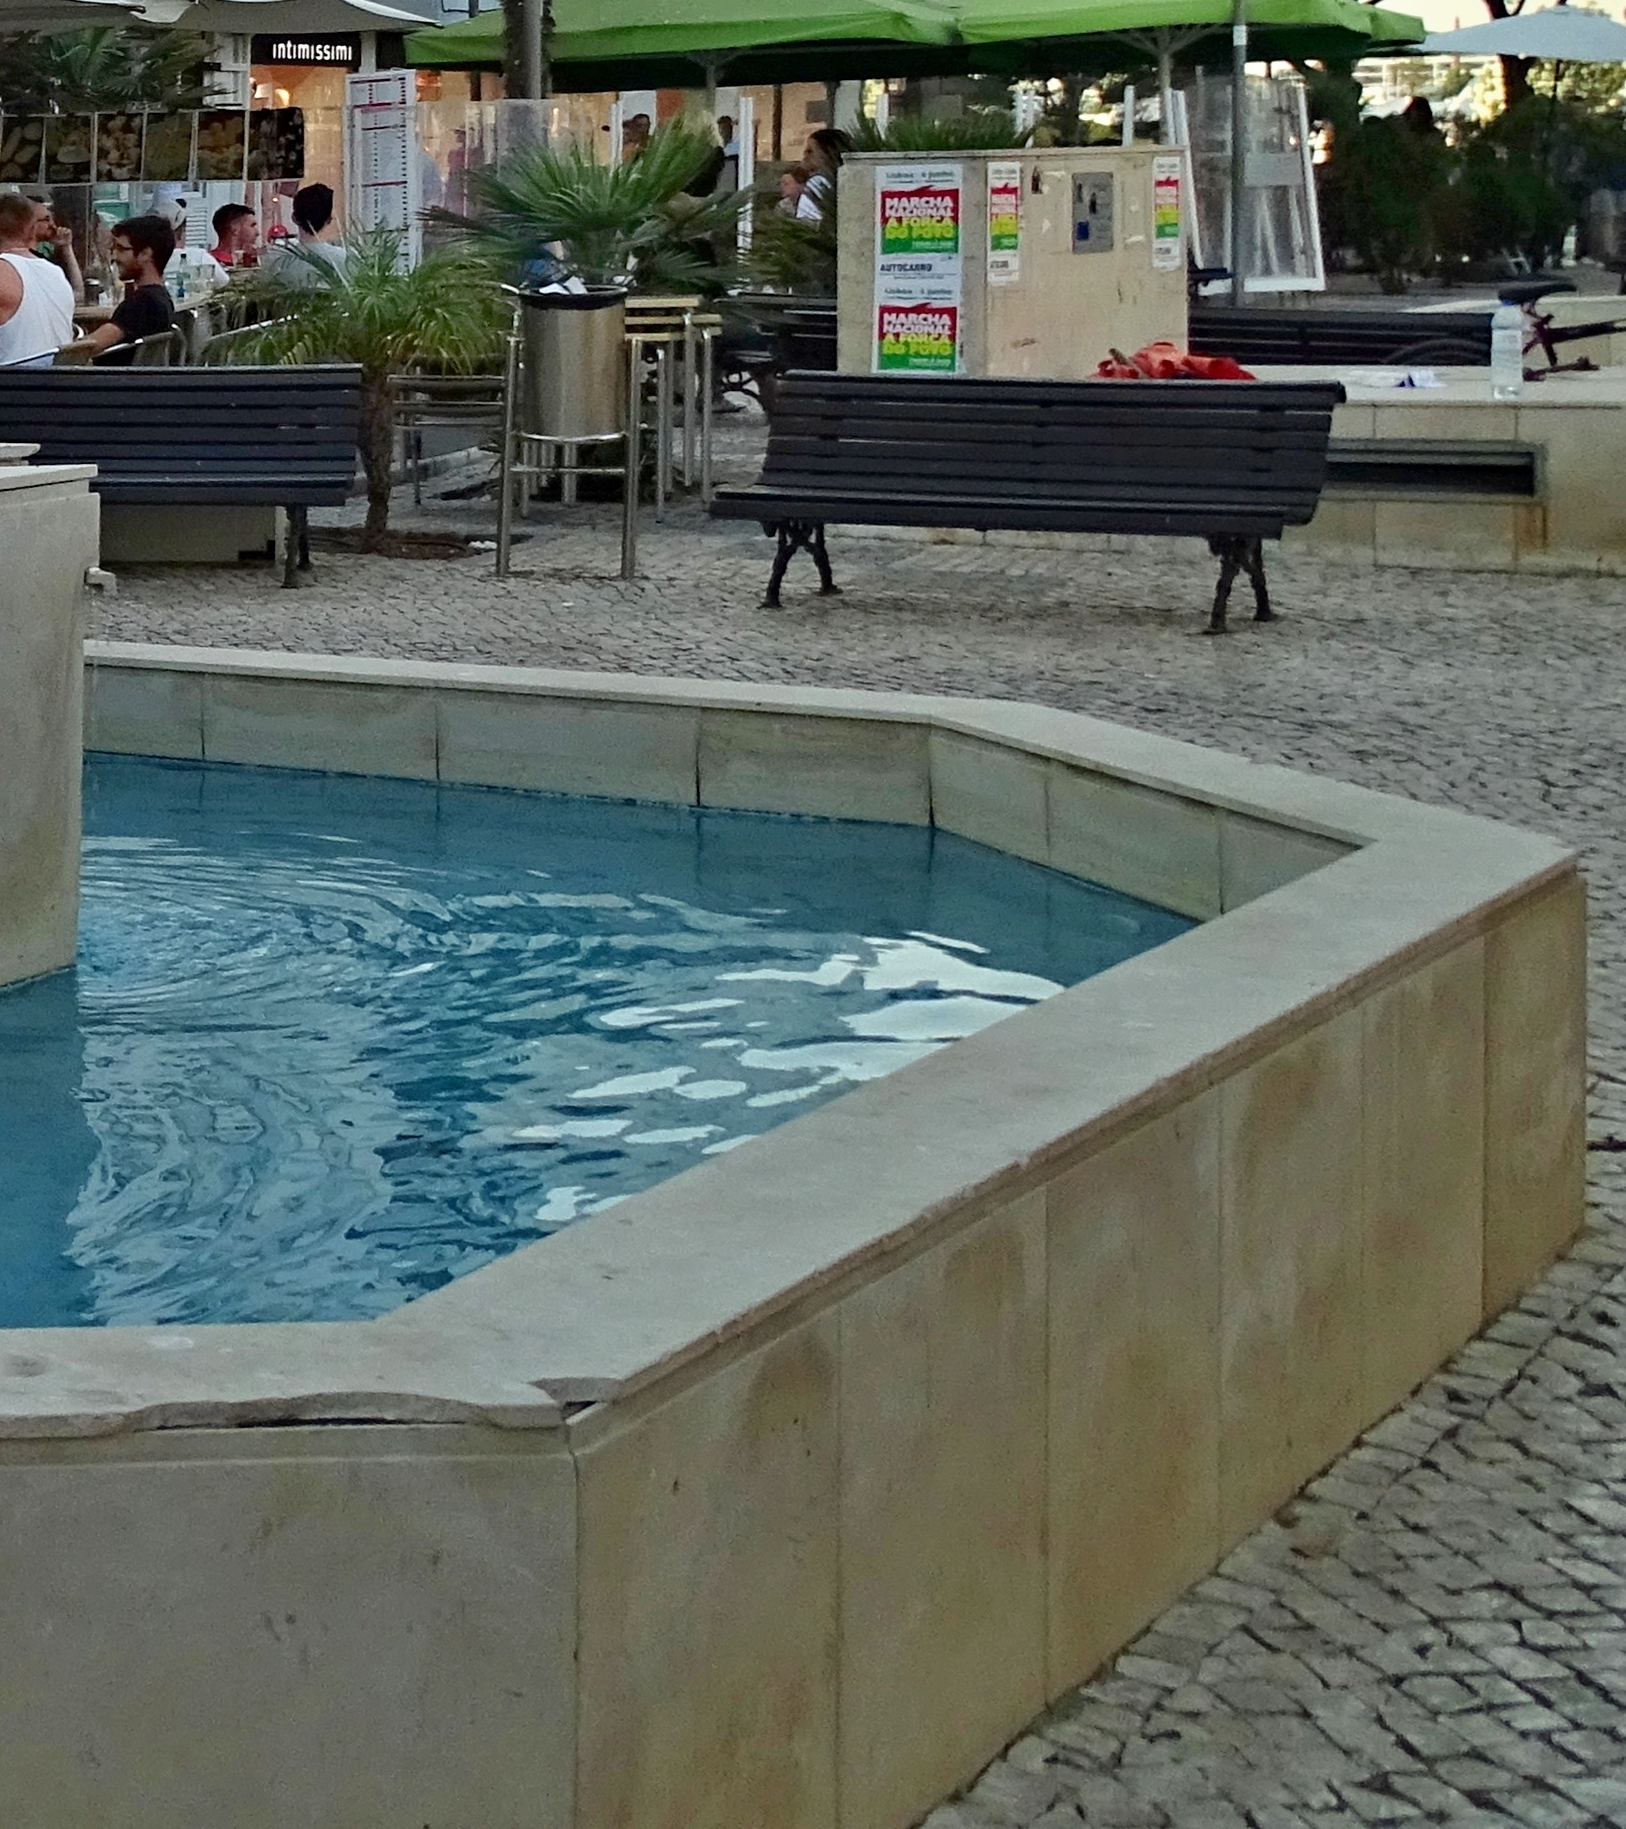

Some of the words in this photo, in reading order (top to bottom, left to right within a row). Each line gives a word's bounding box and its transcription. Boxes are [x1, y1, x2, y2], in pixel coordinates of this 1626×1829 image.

[272, 40, 352, 61] intimissimi
[885, 196, 953, 211] MARCHA
[885, 207, 954, 217] NACIONAL
[883, 313, 951, 325] MARCHA
[883, 324, 951, 334] NACIONAL
